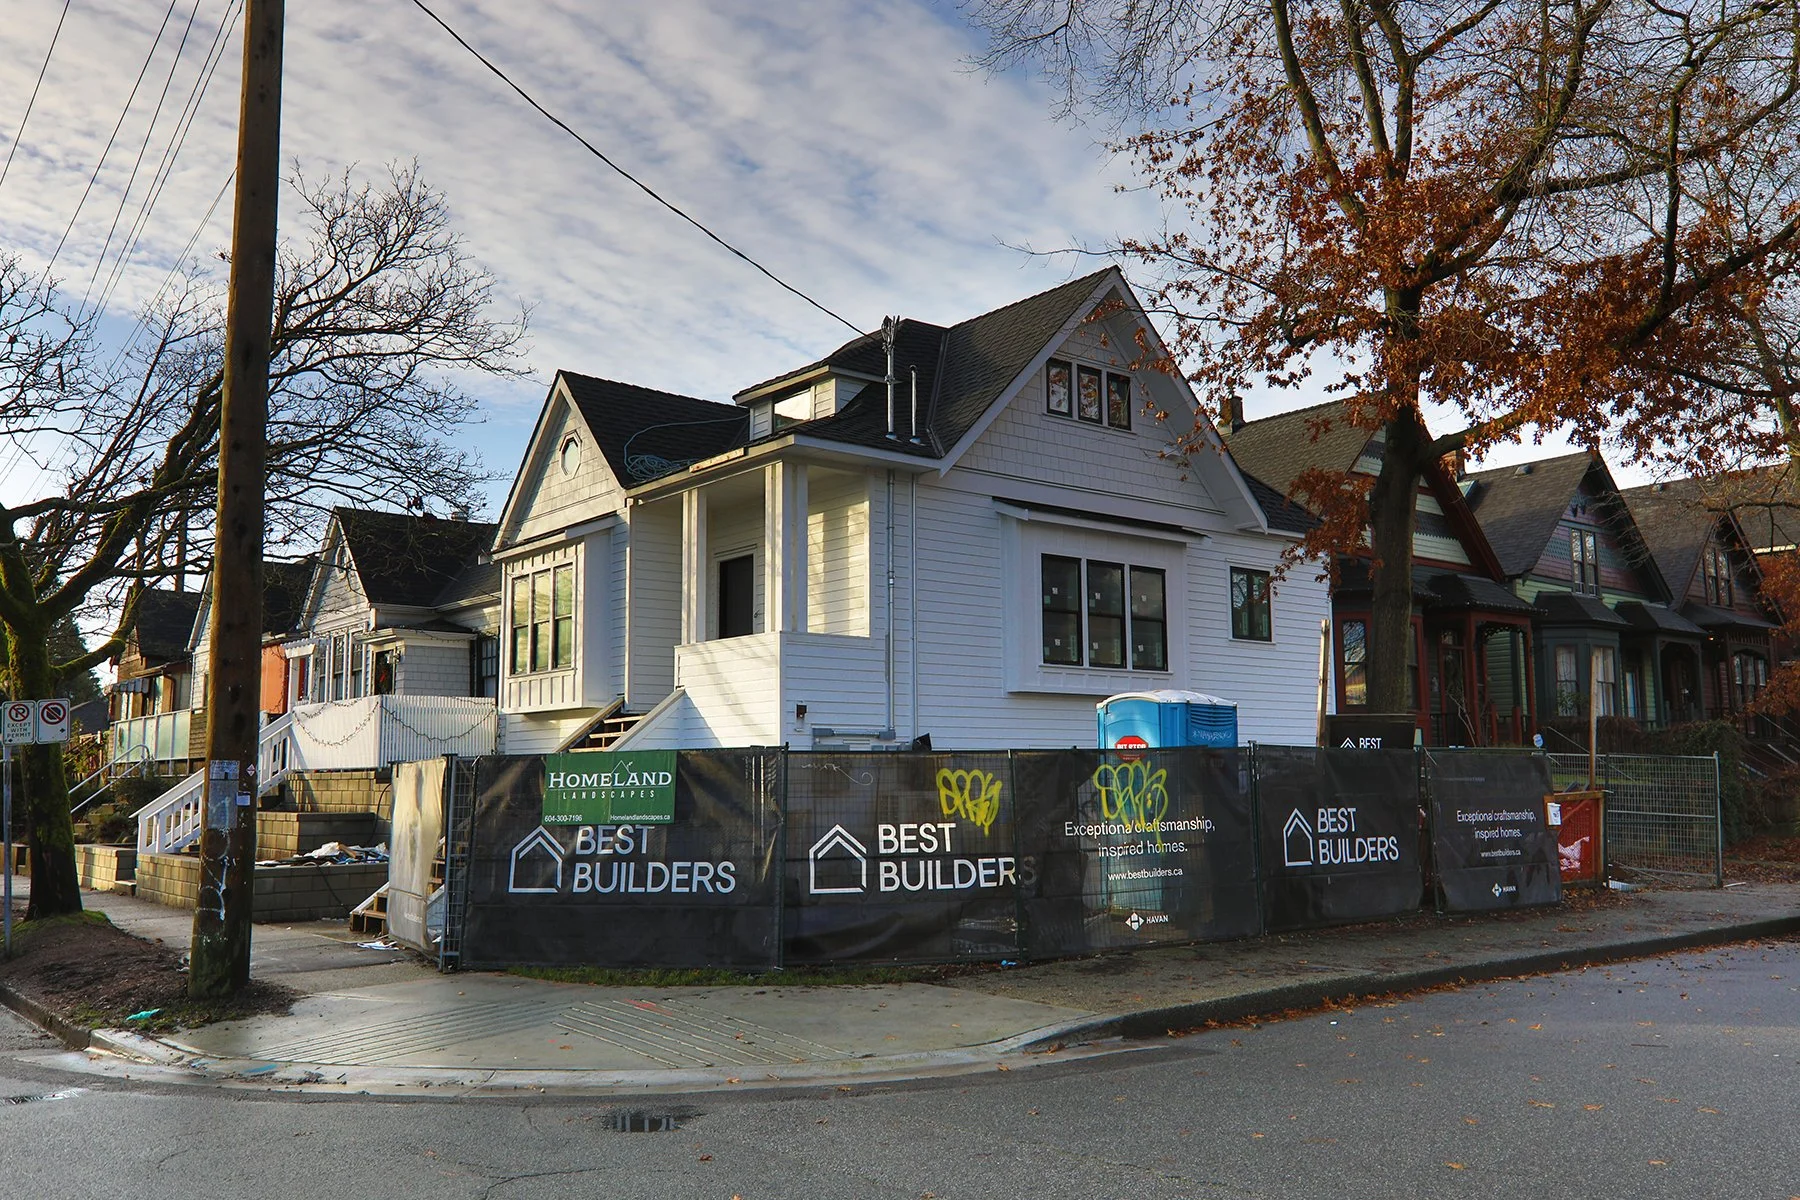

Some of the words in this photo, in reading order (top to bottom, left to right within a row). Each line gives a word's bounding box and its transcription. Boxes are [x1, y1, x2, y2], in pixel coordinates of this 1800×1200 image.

[1359, 737, 1382, 749] BEST
[548, 771, 672, 788] HOMELAND
[562, 790, 655, 800] LANDSCAPES
[544, 814, 583, 823] 604-300-7196
[610, 814, 671, 822] Homelandlandscapes.ca
[1317, 807, 1357, 833] BEST
[1456, 809, 1494, 825] Exceptional
[1494, 808, 1537, 823] craftsmanship,
[1064, 820, 1135, 839] Exceptional
[1135, 816, 1216, 834] craftsmanship,
[1474, 827, 1499, 842] inspired
[1500, 826, 1522, 838] homes.
[575, 825, 655, 855] BEST
[878, 823, 957, 854] BEST
[1098, 841, 1144, 860] inspired
[1147, 840, 1188, 855] homes.
[1318, 836, 1399, 865] BUILDERS
[572, 862, 737, 894] BUILDERS
[1108, 867, 1184, 881] www.bestbuilders.ca
[1146, 915, 1169, 924] HAVAN
